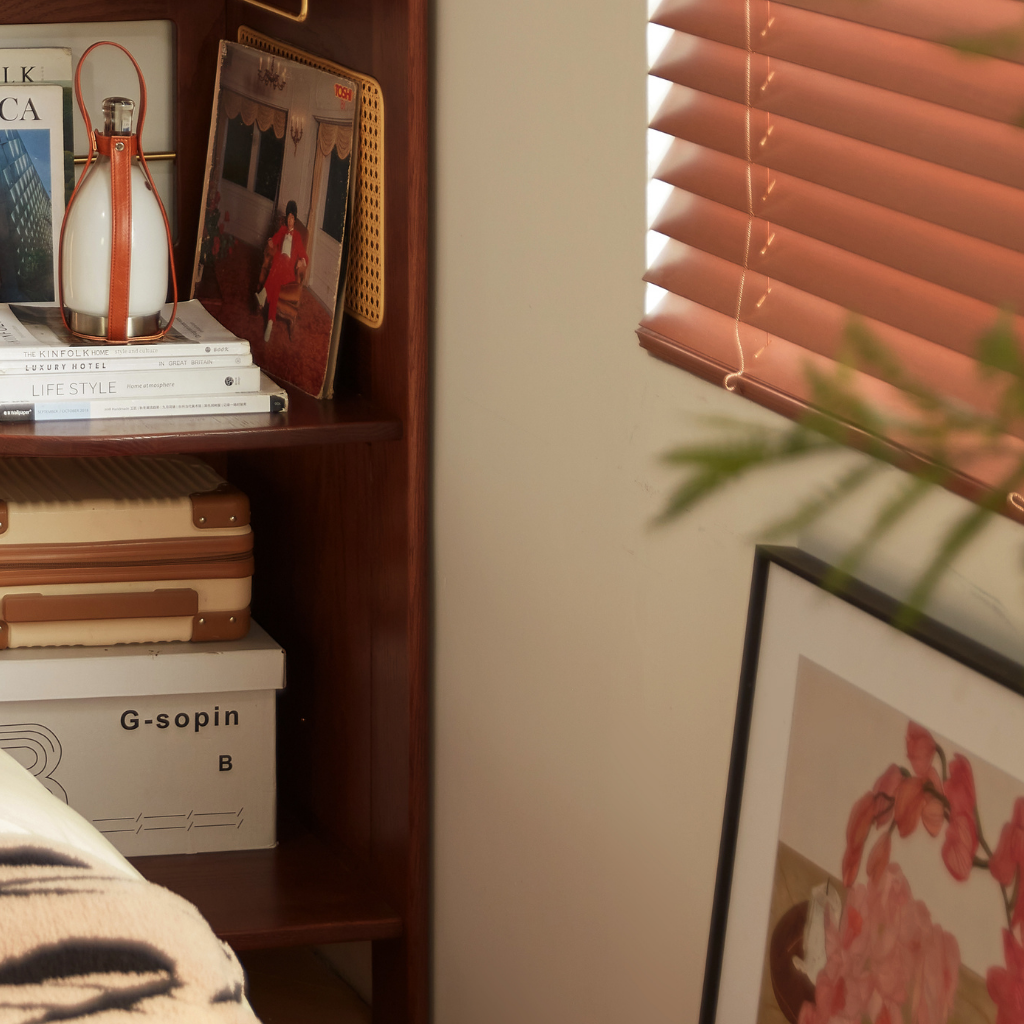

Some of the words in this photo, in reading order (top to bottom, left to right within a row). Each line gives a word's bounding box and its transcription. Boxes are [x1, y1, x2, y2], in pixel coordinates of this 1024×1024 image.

[39, 349, 90, 358] KINFOLK
[72, 362, 107, 370] HOTEL
[32, 383, 65, 397] LIFE
[69, 381, 117, 396] STYLE
[120, 706, 239, 732] G-sopin
[218, 754, 233, 772] B
